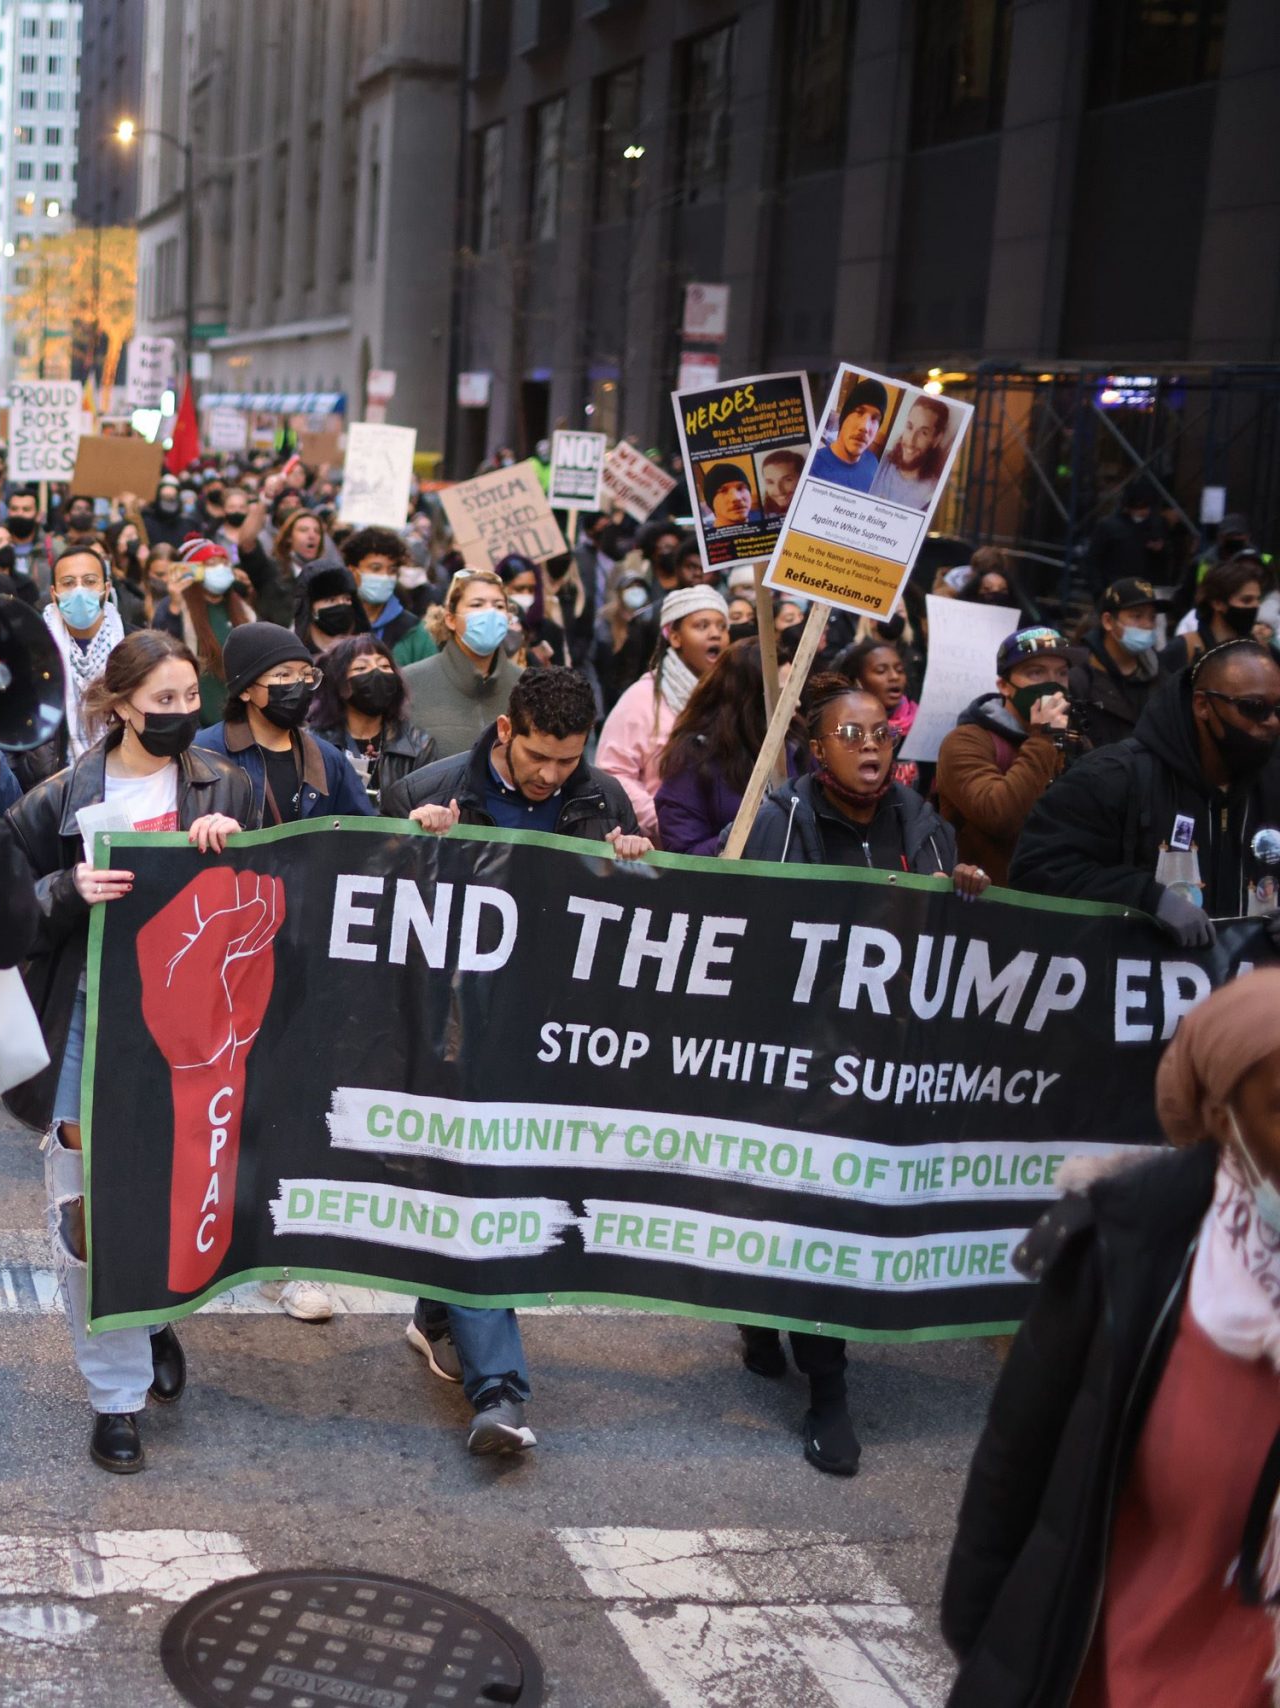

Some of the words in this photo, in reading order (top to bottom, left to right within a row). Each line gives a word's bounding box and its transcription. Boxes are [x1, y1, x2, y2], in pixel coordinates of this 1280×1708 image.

[9, 385, 78, 407] PROUD
[686, 385, 755, 435] HEROES
[754, 400, 777, 413] killed
[778, 398, 802, 407] while
[22, 411, 69, 428] BOYS
[712, 428, 736, 439] Black
[738, 424, 757, 434] lives
[759, 420, 775, 430] and
[776, 415, 804, 430] justice
[742, 412, 777, 425] standing
[779, 408, 788, 418] up
[15, 429, 74, 447] SUCK
[559, 435, 601, 469] NO!
[728, 435, 743, 445] the
[744, 428, 781, 443] beautiful
[782, 424, 806, 436] rising
[18, 447, 76, 472] EGGS
[462, 477, 528, 513] SYSTEM
[478, 504, 538, 539] FIXED
[812, 513, 838, 529] Against
[840, 520, 862, 535] White
[861, 528, 898, 548] Supremacy
[833, 504, 858, 519] Heroes
[859, 513, 866, 522] in
[867, 515, 888, 530] Rising
[782, 549, 791, 557] We
[790, 551, 815, 566] Refuse
[816, 559, 823, 567] to
[823, 562, 846, 577] Accept
[851, 569, 874, 583] Fascist
[874, 576, 898, 590] America
[808, 545, 815, 553] In
[815, 546, 826, 557] the
[826, 551, 845, 563] Name
[845, 556, 853, 565] of
[853, 558, 881, 575] Humanity
[784, 568, 882, 608] RefuseFascism.org
[328, 873, 519, 973] END
[567, 895, 748, 997] THE
[790, 921, 1088, 1034] TRUMP
[1114, 958, 1255, 1042] ER
[537, 1021, 651, 1070] STOP
[671, 1035, 813, 1090] WHITE
[830, 1053, 1062, 1106] SUPREMACY
[366, 1103, 618, 1156] COMMUNITY
[623, 1124, 822, 1183] CONTROL
[831, 1152, 890, 1191] OF
[897, 1159, 945, 1194] THE
[950, 1154, 1066, 1188] POLICE
[196, 1087, 233, 1254] CPAC
[286, 1187, 460, 1241] DEFUND
[470, 1210, 542, 1247] CPD
[592, 1212, 699, 1254] FREE
[706, 1225, 859, 1281] POLICE
[870, 1242, 1010, 1285] TORTURE
[270, 1669, 397, 1708] CHICAGO
